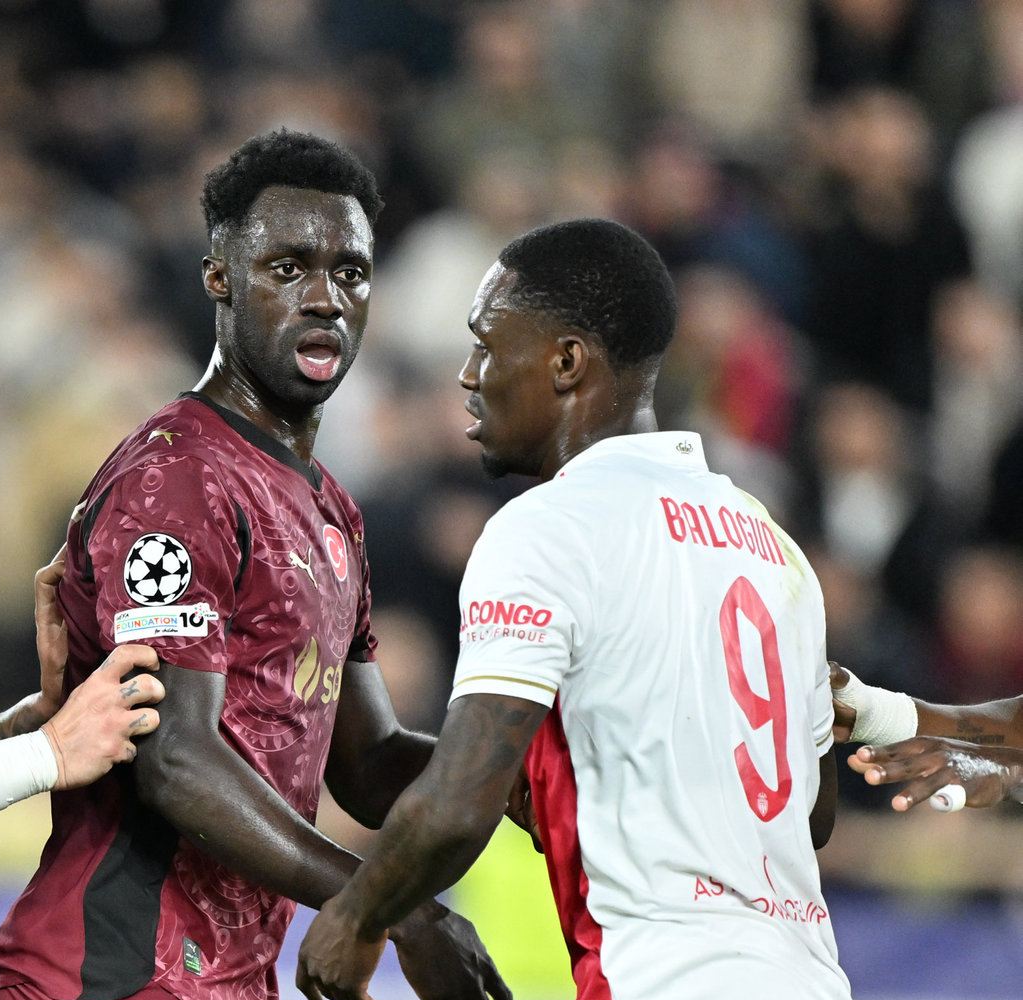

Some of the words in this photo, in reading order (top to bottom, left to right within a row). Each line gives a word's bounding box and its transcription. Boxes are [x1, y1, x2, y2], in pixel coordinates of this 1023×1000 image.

[659, 497, 786, 566] BALOGUN
[116, 617, 178, 631] FOUNDATION
[179, 612, 204, 628] 10
[469, 600, 552, 627] CONGO
[719, 575, 792, 823] 9
